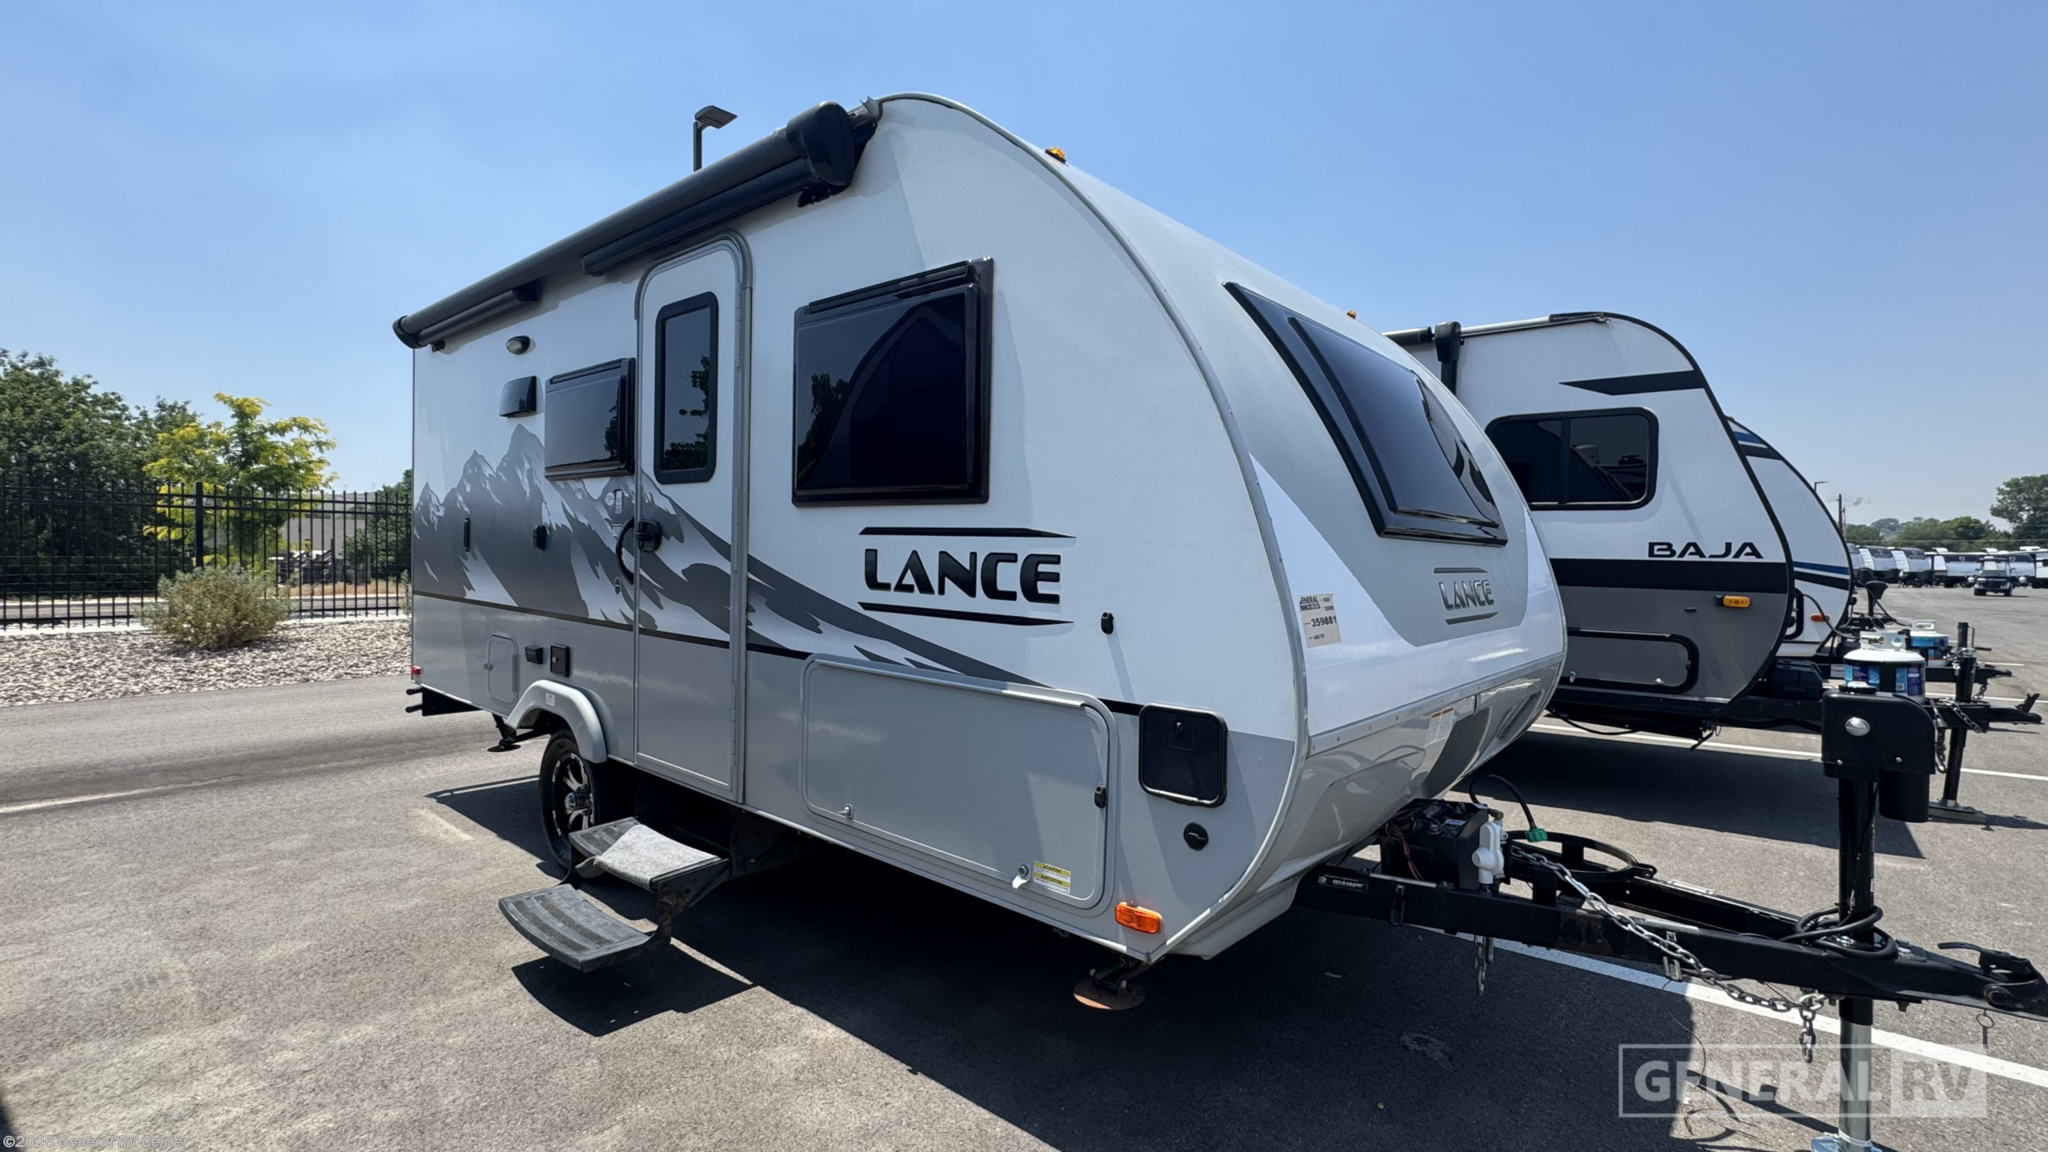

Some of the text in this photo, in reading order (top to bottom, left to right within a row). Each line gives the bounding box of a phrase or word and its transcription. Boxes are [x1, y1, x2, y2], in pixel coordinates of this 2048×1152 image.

[1647, 541, 1765, 560] BAJA
[864, 548, 1062, 605] LANCE
[1438, 579, 1495, 611] LANCE
